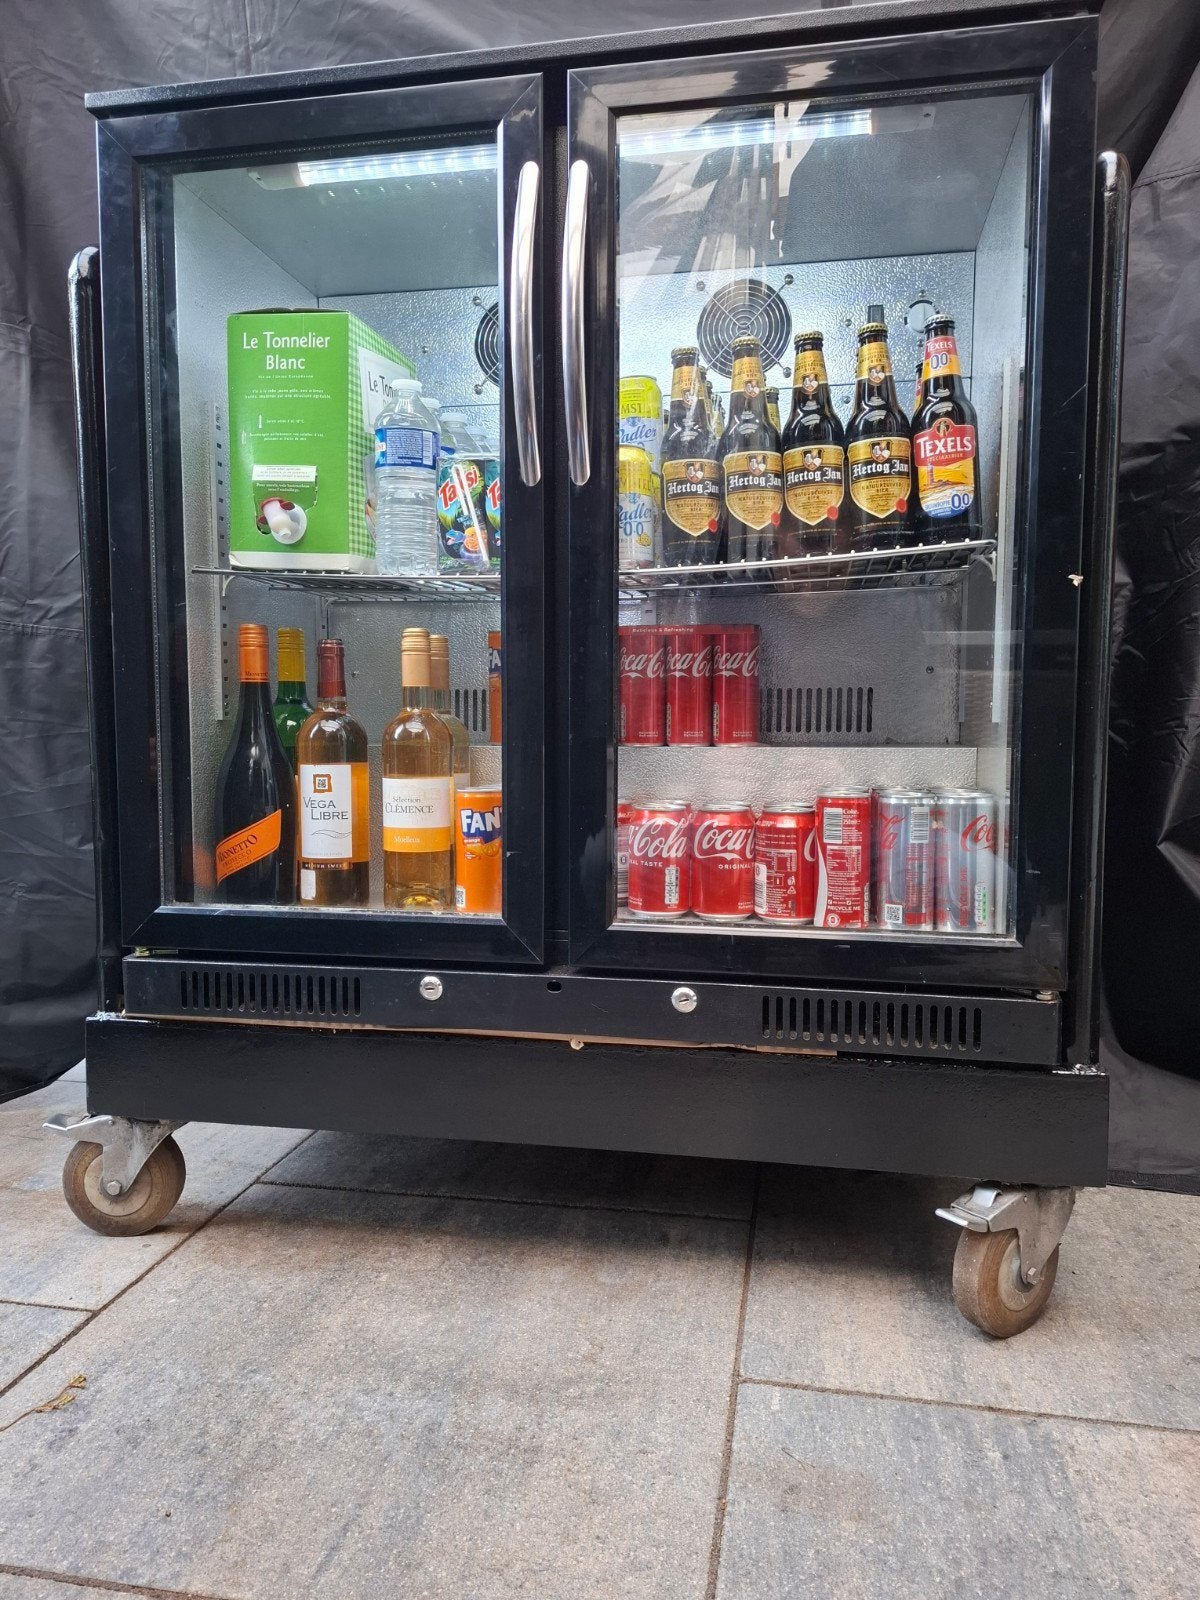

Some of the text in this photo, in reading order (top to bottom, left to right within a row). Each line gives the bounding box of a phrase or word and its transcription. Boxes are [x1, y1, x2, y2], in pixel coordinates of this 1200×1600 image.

[243, 331, 331, 349] Le Tonnelier
[926, 340, 953, 354] TEXELS
[266, 354, 306, 370] Blanc
[367, 370, 379, 393] Le
[916, 436, 973, 459] TEXELS
[787, 466, 842, 488] Hertog Jan
[852, 459, 909, 481] Hertog Jan
[439, 466, 480, 510] Tasi
[667, 481, 704, 498] Hertog
[728, 473, 782, 491] Hertog Jan
[303, 796, 336, 809] VEGA
[311, 809, 349, 821] LIBRE
[461, 806, 502, 834] FAN
[641, 860, 663, 868] TASTE
[718, 862, 751, 870] ORIGINAL
